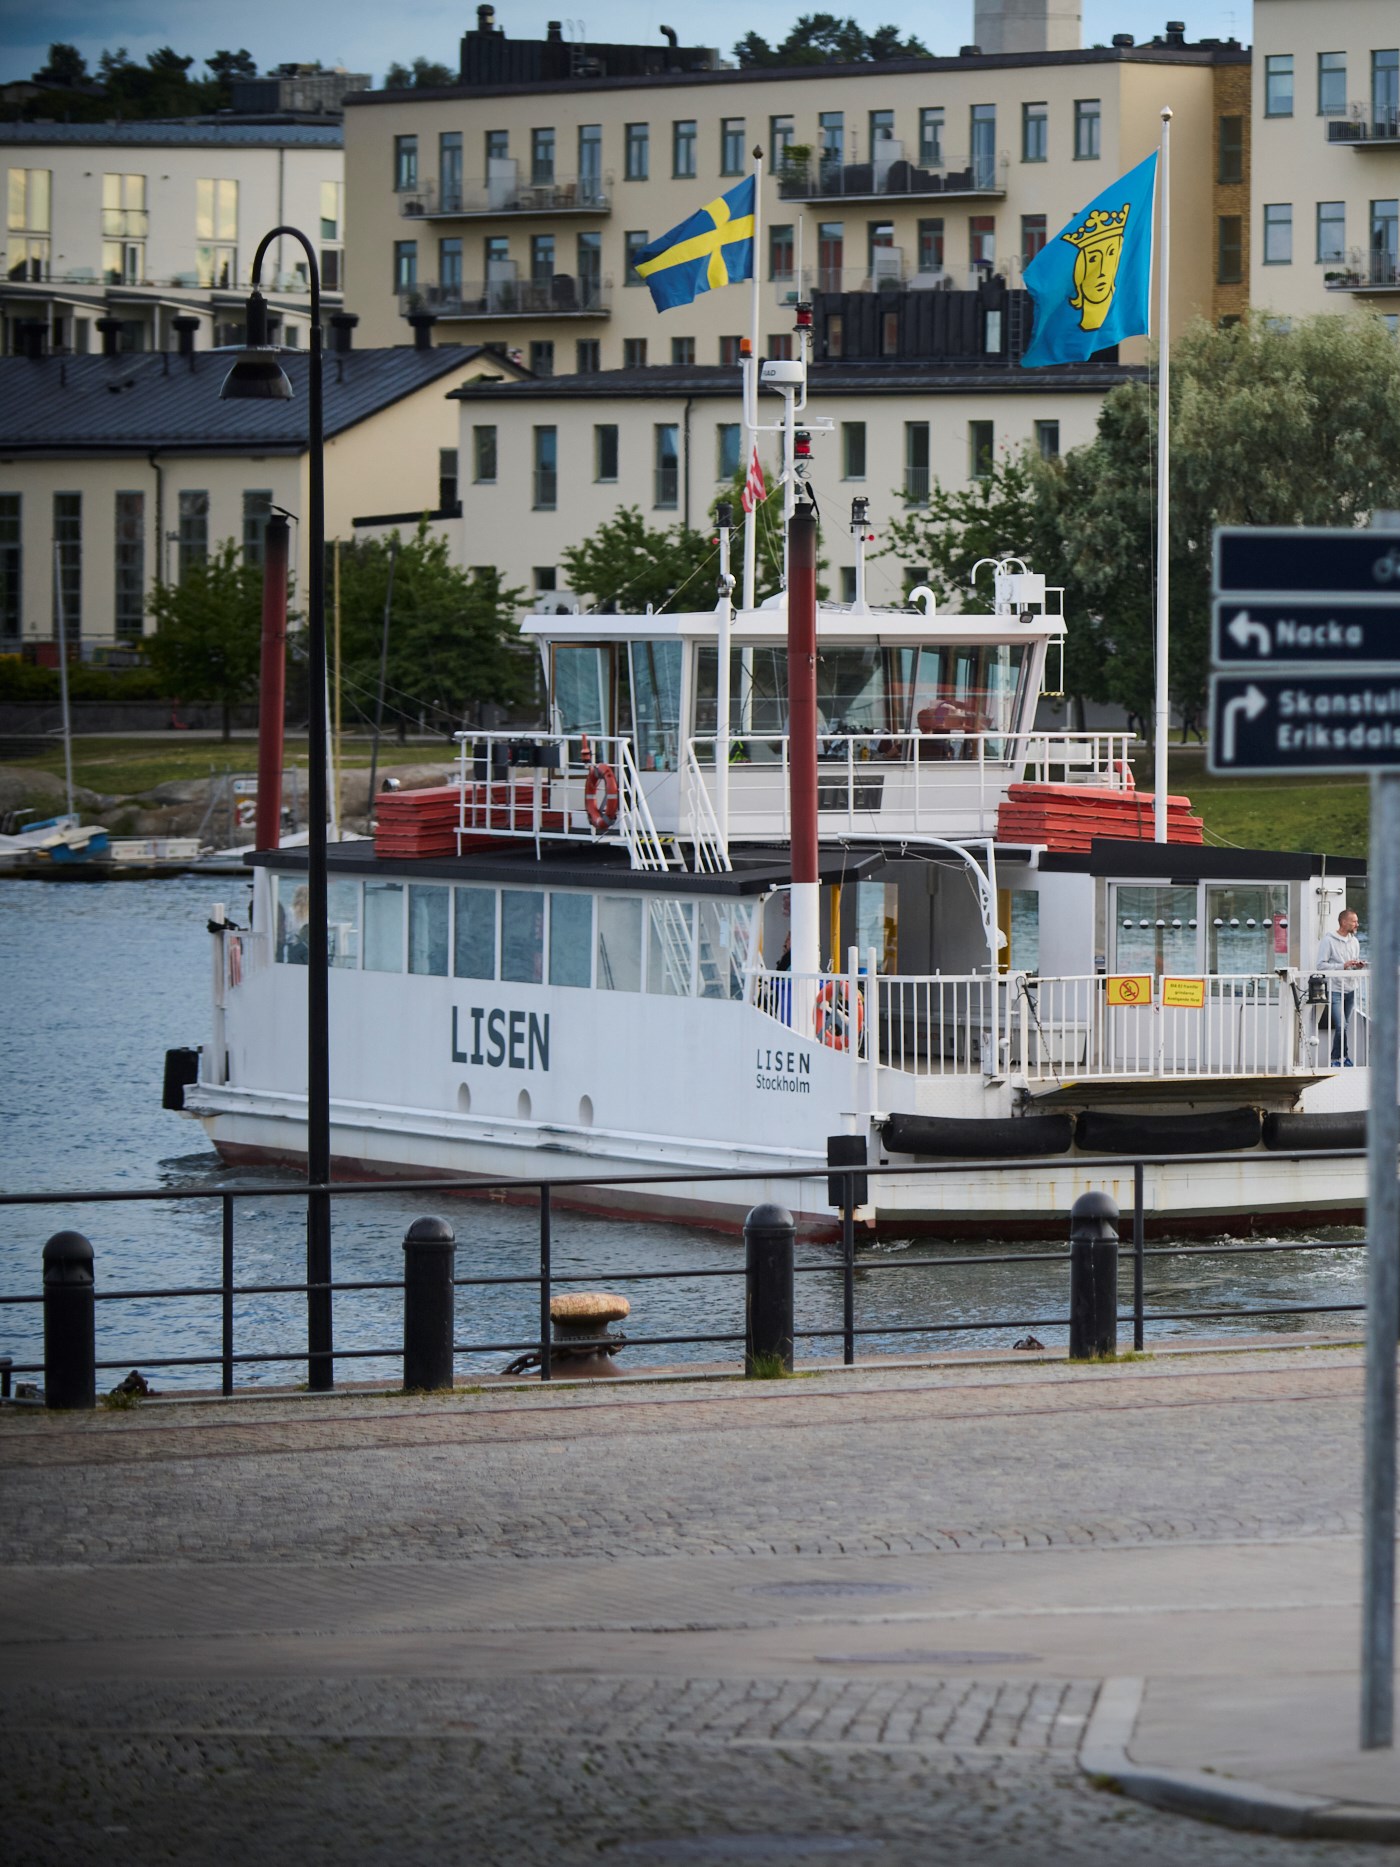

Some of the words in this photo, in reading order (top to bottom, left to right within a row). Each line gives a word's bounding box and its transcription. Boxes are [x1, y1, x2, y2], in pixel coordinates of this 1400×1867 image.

[1276, 619, 1363, 648] Nacka
[451, 1005, 550, 1072] LISEN
[756, 1048, 811, 1074] LISEN
[756, 1073, 811, 1094] Stockholm
